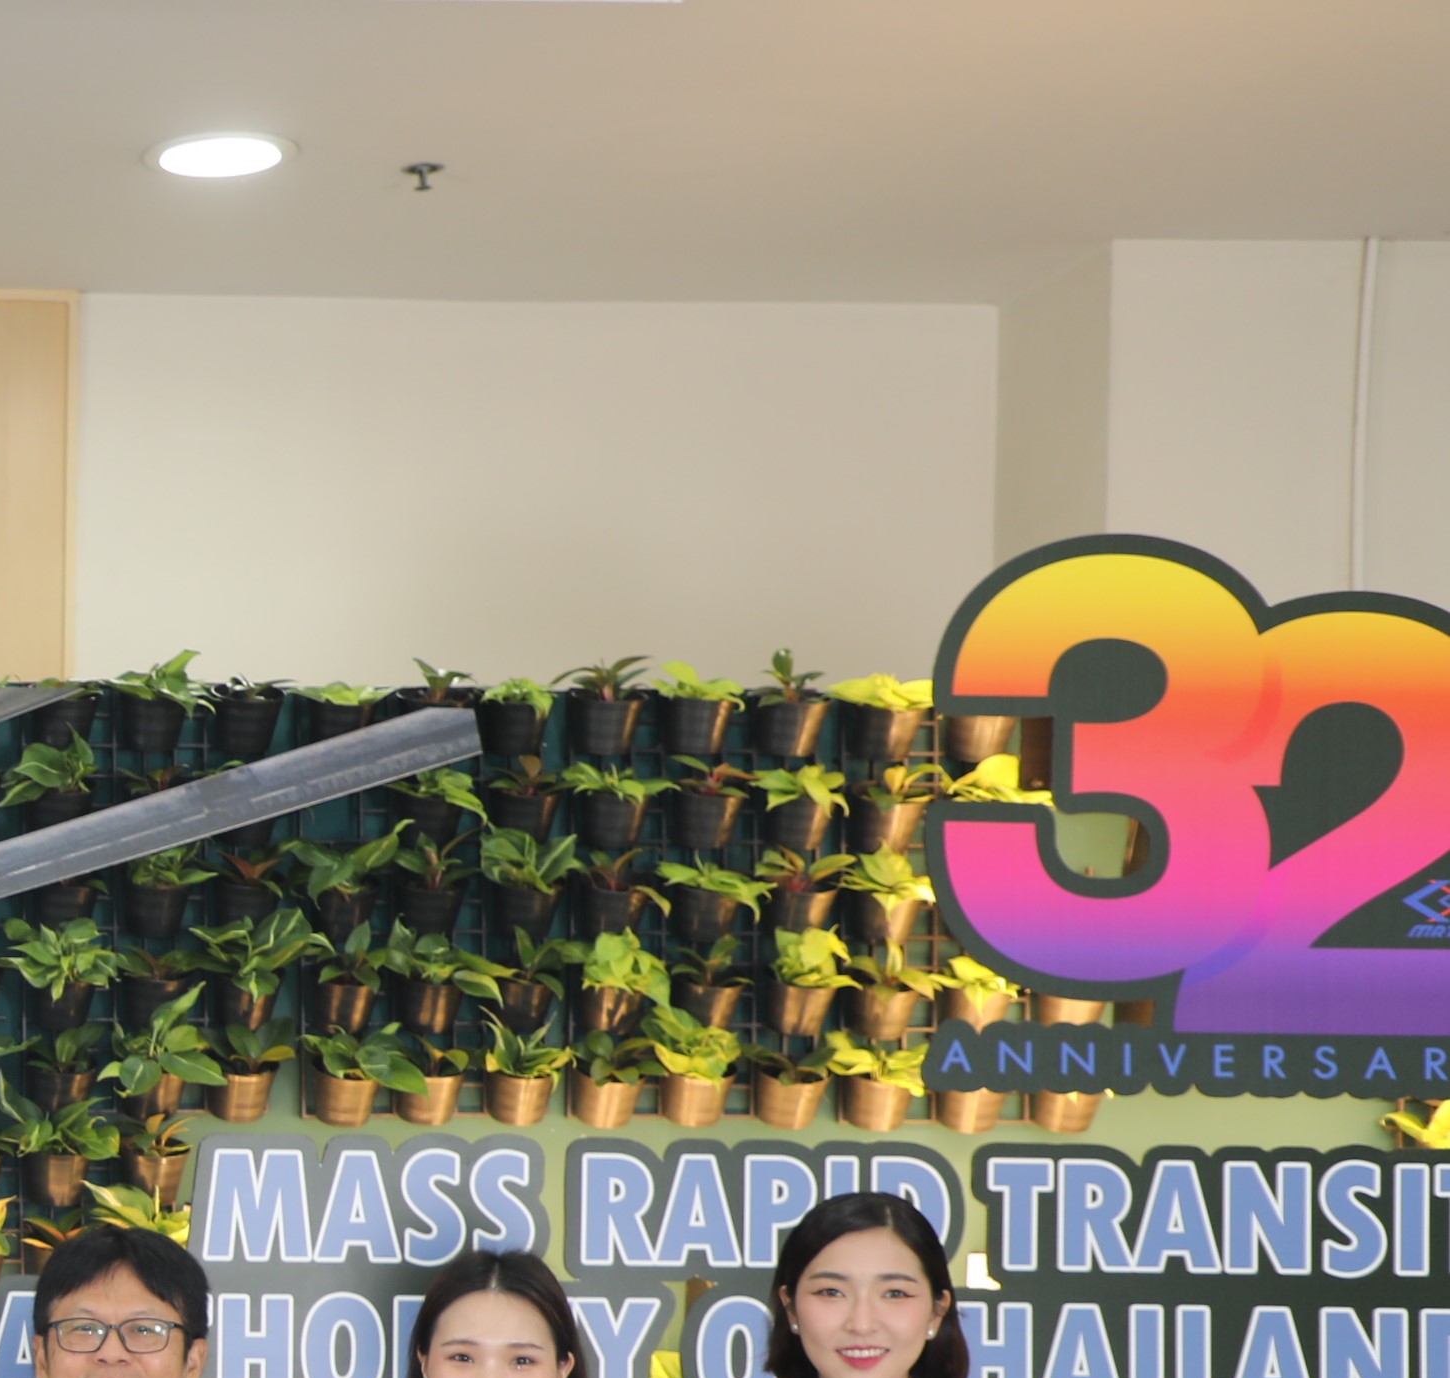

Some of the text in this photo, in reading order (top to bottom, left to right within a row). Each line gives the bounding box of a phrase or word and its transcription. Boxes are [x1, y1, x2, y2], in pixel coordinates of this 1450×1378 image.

[943, 553, 1450, 1036] 32
[1407, 924, 1450, 938] MR
[941, 1039, 1449, 1081] ANNIVERSAR
[203, 1148, 536, 1265] MASS
[987, 1157, 1450, 1278] TRANSI
